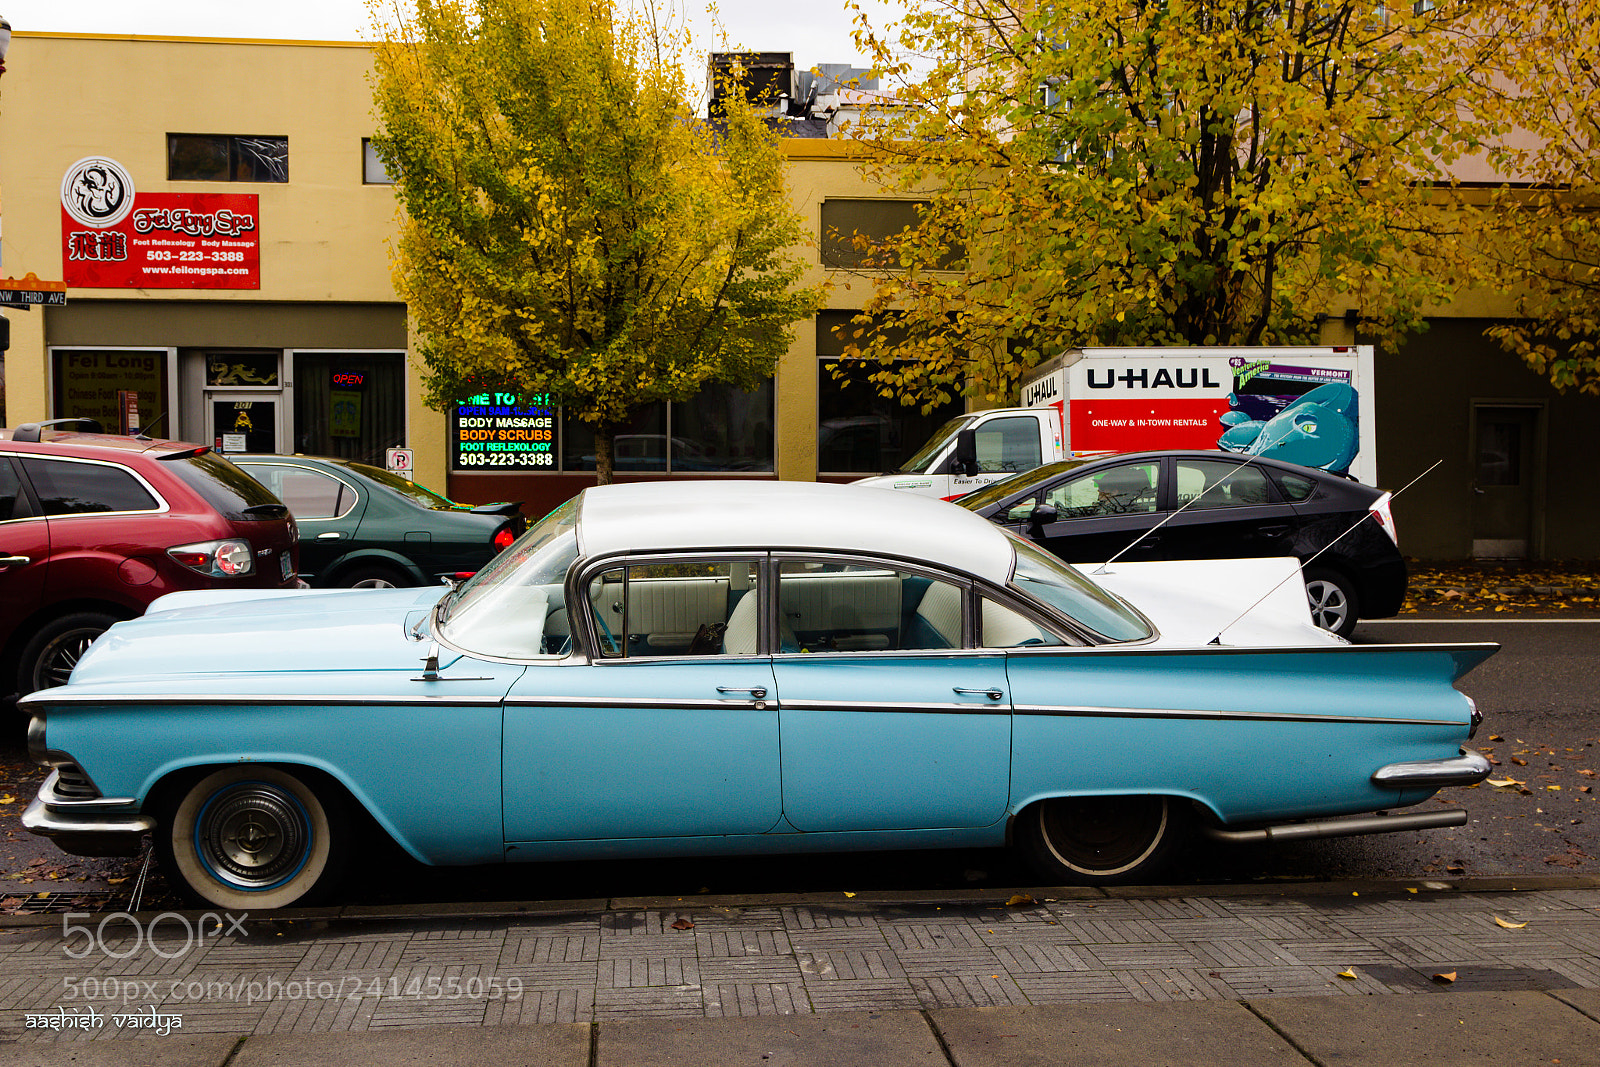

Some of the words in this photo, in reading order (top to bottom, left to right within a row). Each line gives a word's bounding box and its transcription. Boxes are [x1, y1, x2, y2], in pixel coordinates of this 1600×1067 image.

[133, 209, 171, 233] Fei
[171, 209, 214, 236] Long
[215, 210, 254, 236] Spa
[69, 231, 128, 261] 飛龍
[152, 239, 196, 247] Reflexology
[201, 240, 220, 248] Body
[146, 250, 244, 261] 503-223-3388
[142, 266, 249, 276] www.feilongspa.com
[0, 291, 13, 302] NW
[20, 291, 44, 303] THIRD
[48, 292, 65, 304] AVE
[68, 353, 98, 368] Fei
[105, 353, 154, 371] Long
[333, 373, 364, 384] OPEN
[1087, 368, 1220, 389] U-HAUL
[1311, 369, 1348, 378] VERMONT
[458, 406, 487, 416] OPEN
[459, 417, 494, 428] BODY
[495, 417, 552, 428] MASSAGE
[1092, 419, 1128, 427] ONE-WAY
[1128, 419, 1136, 427] &
[1137, 419, 1171, 427] IN-TOWN
[1173, 418, 1208, 427] RENTALS
[459, 429, 497, 441] BODY
[498, 429, 552, 441] SCRUBS
[460, 442, 486, 452] FOOT
[486, 442, 552, 452] REFLEXOLOGY
[459, 453, 553, 466] 503-223-3388
